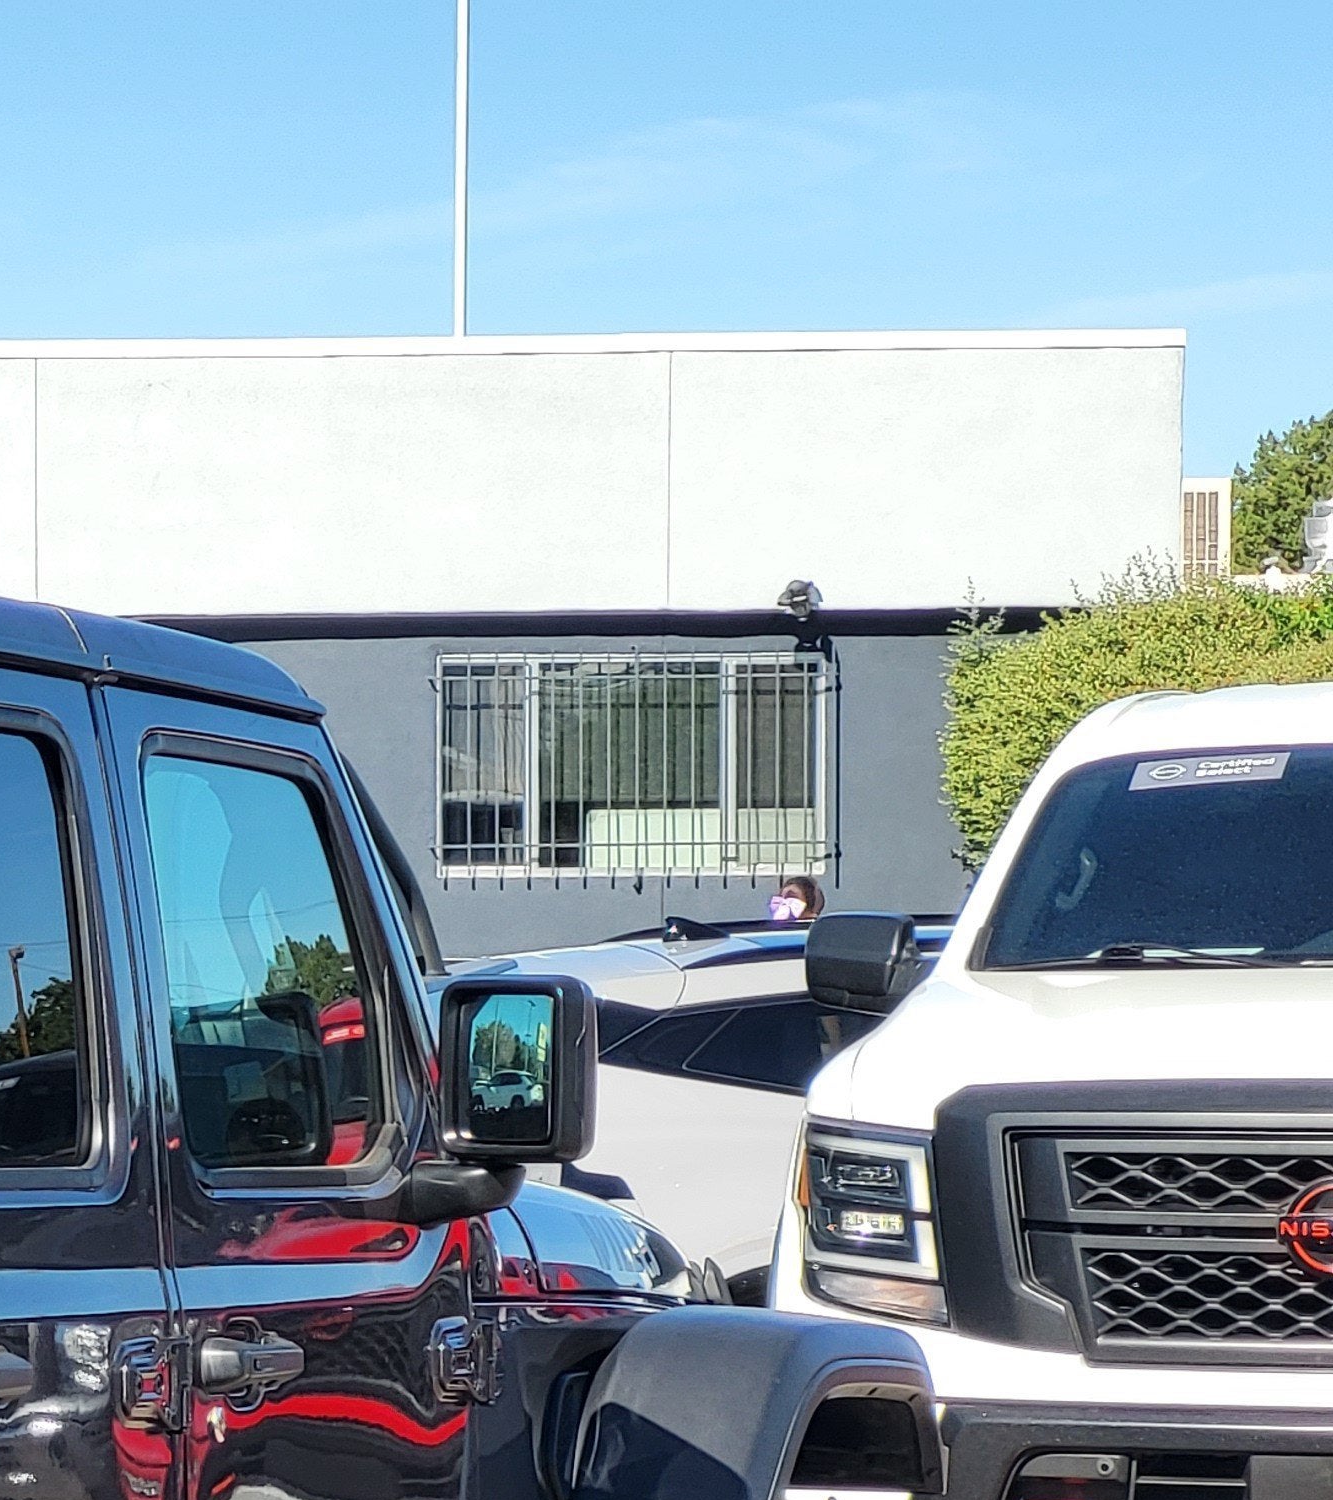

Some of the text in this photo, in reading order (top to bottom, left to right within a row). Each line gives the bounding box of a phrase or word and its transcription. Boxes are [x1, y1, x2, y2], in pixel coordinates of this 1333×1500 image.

[1198, 757, 1276, 768] Certified
[1195, 767, 1252, 777] Select
[1279, 1220, 1331, 1238] NIS
